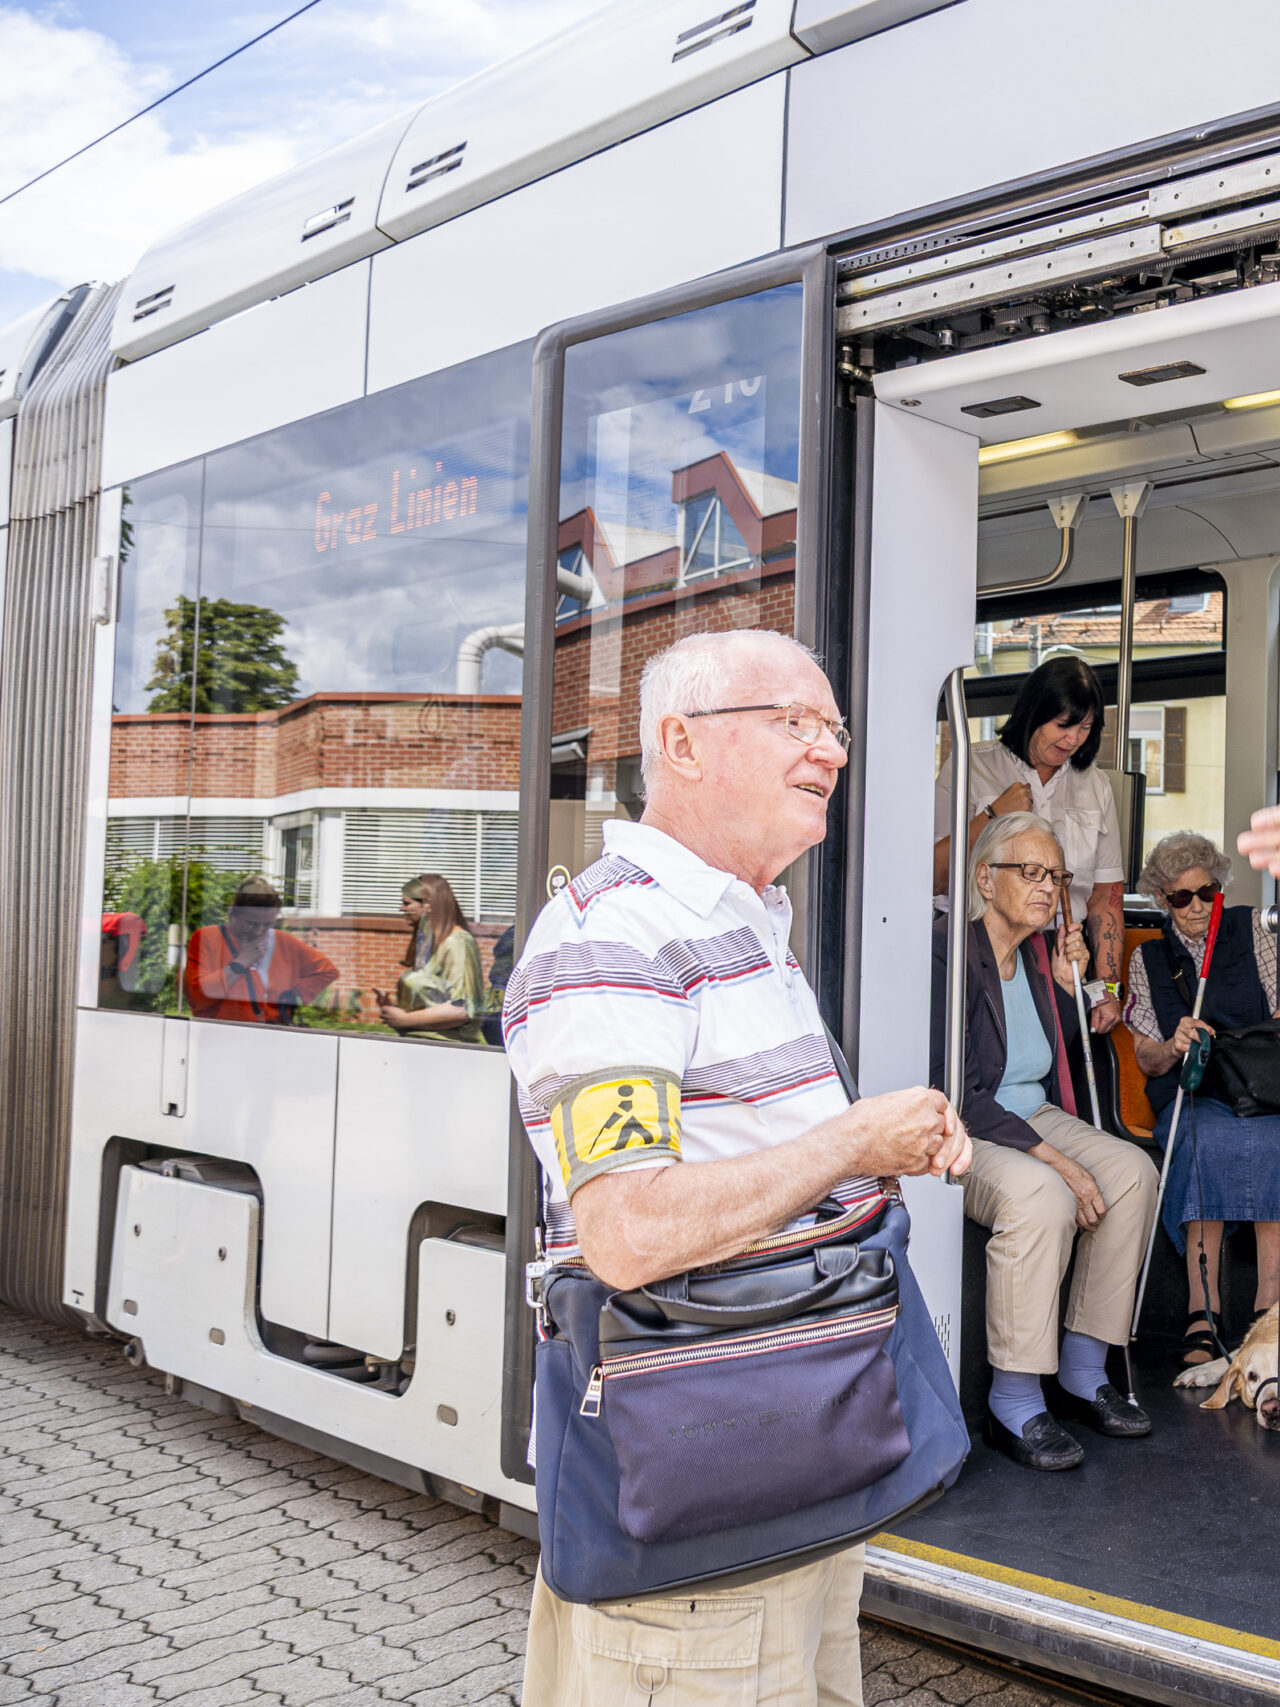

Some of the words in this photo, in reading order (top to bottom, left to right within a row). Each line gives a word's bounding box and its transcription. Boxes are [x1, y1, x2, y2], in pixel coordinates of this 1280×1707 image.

[315, 491, 379, 552] Graz
[390, 461, 478, 534] Linien
[668, 1416, 752, 1440] TOMMY
